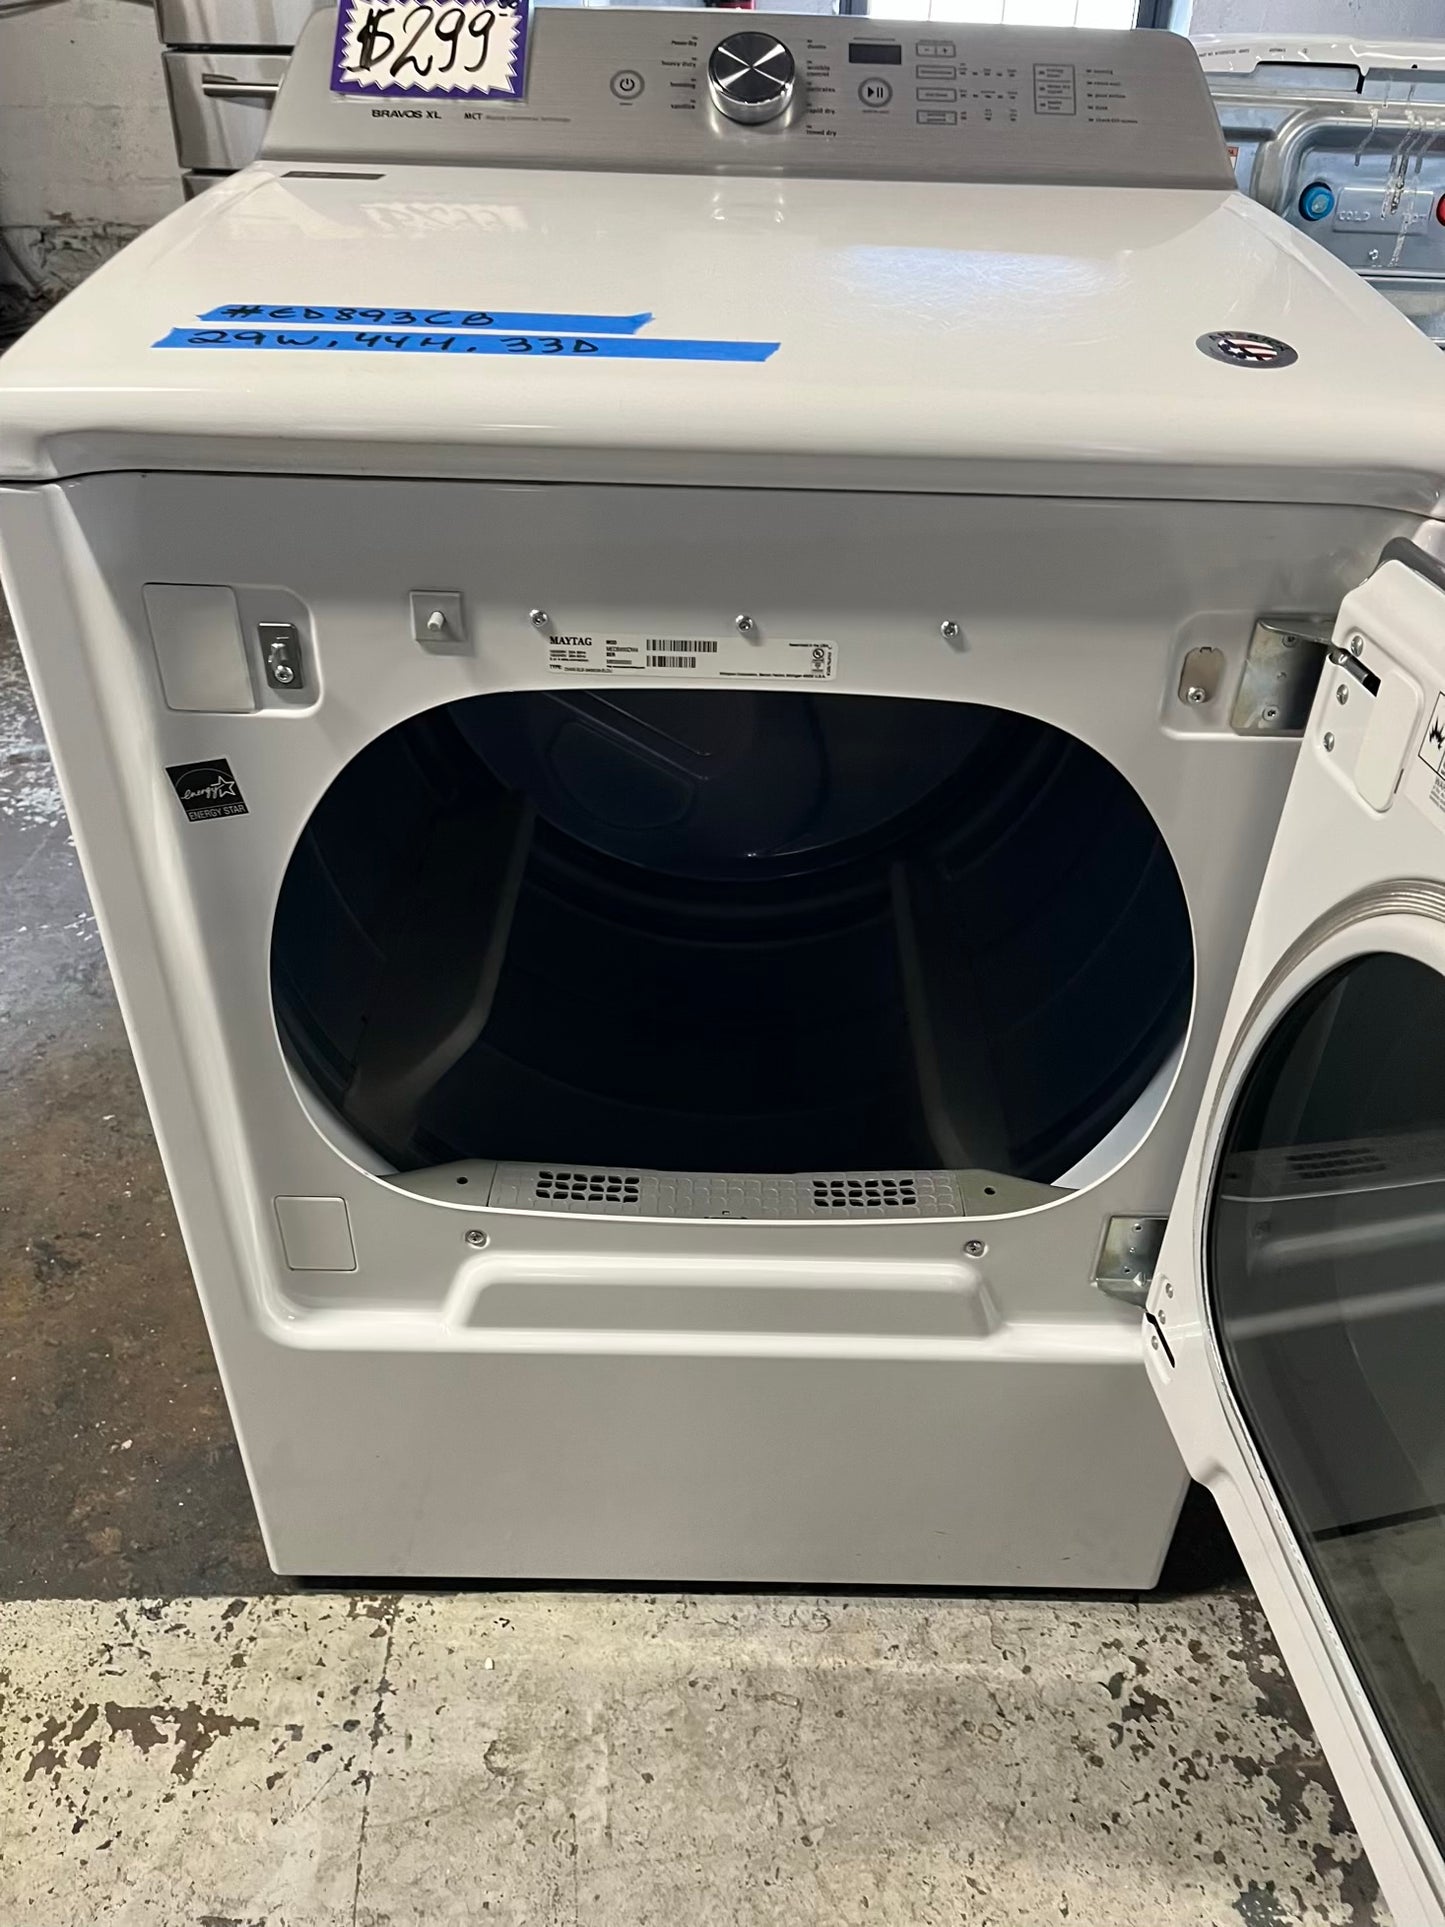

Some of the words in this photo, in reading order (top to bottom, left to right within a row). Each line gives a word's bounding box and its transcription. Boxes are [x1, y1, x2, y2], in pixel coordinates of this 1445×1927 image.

[371, 109, 422, 119] BRAVOS
[426, 110, 442, 119] XL
[549, 636, 592, 646] MAYTAG
[188, 808, 222, 821] ENERGY
[223, 804, 246, 816] STAR
